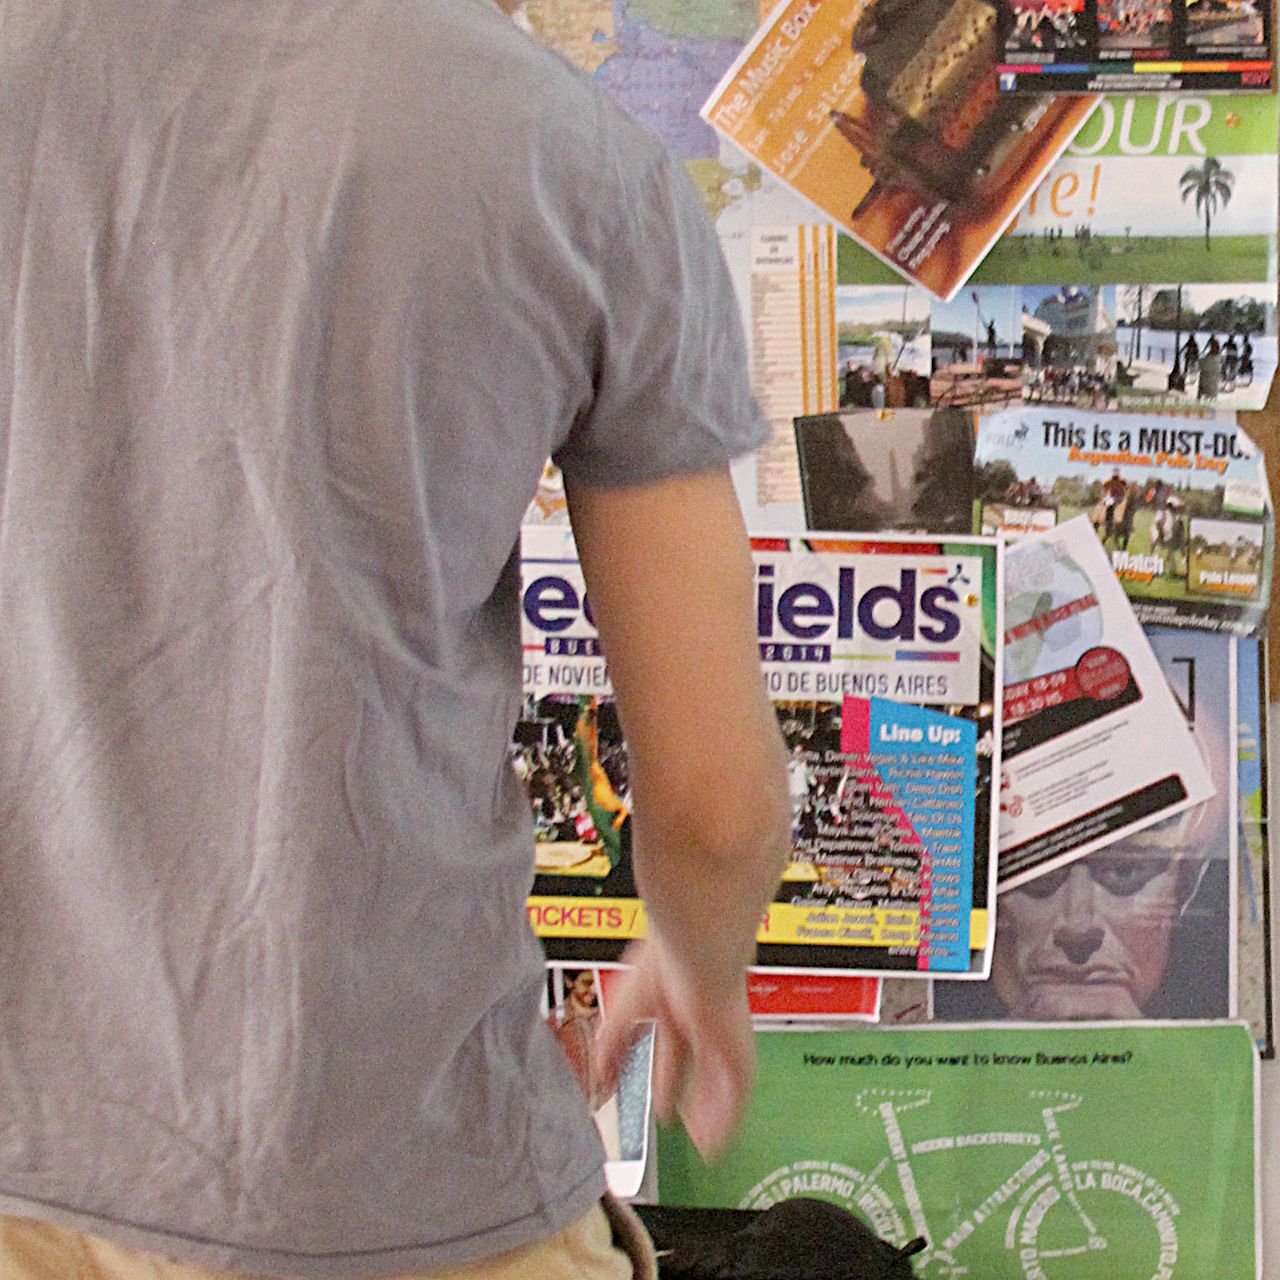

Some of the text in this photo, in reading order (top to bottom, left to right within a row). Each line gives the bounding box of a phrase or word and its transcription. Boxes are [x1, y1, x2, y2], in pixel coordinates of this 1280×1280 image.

[712, 88, 751, 129] The
[736, 34, 791, 97] Music
[1042, 421, 1251, 460] This is a MUST-DO
[1155, 451, 1191, 469] Polo
[1195, 453, 1230, 475] Day
[1112, 550, 1164, 575] Match
[765, 646, 824, 660] 2014
[787, 672, 948, 696] DE BUENOS AIRES
[880, 724, 961, 746] Line Up:
[526, 905, 622, 928] TICKETS
[803, 1051, 1133, 1068] How much do you want to know Buenos Aires?
[1074, 1173, 1096, 1191] LA
